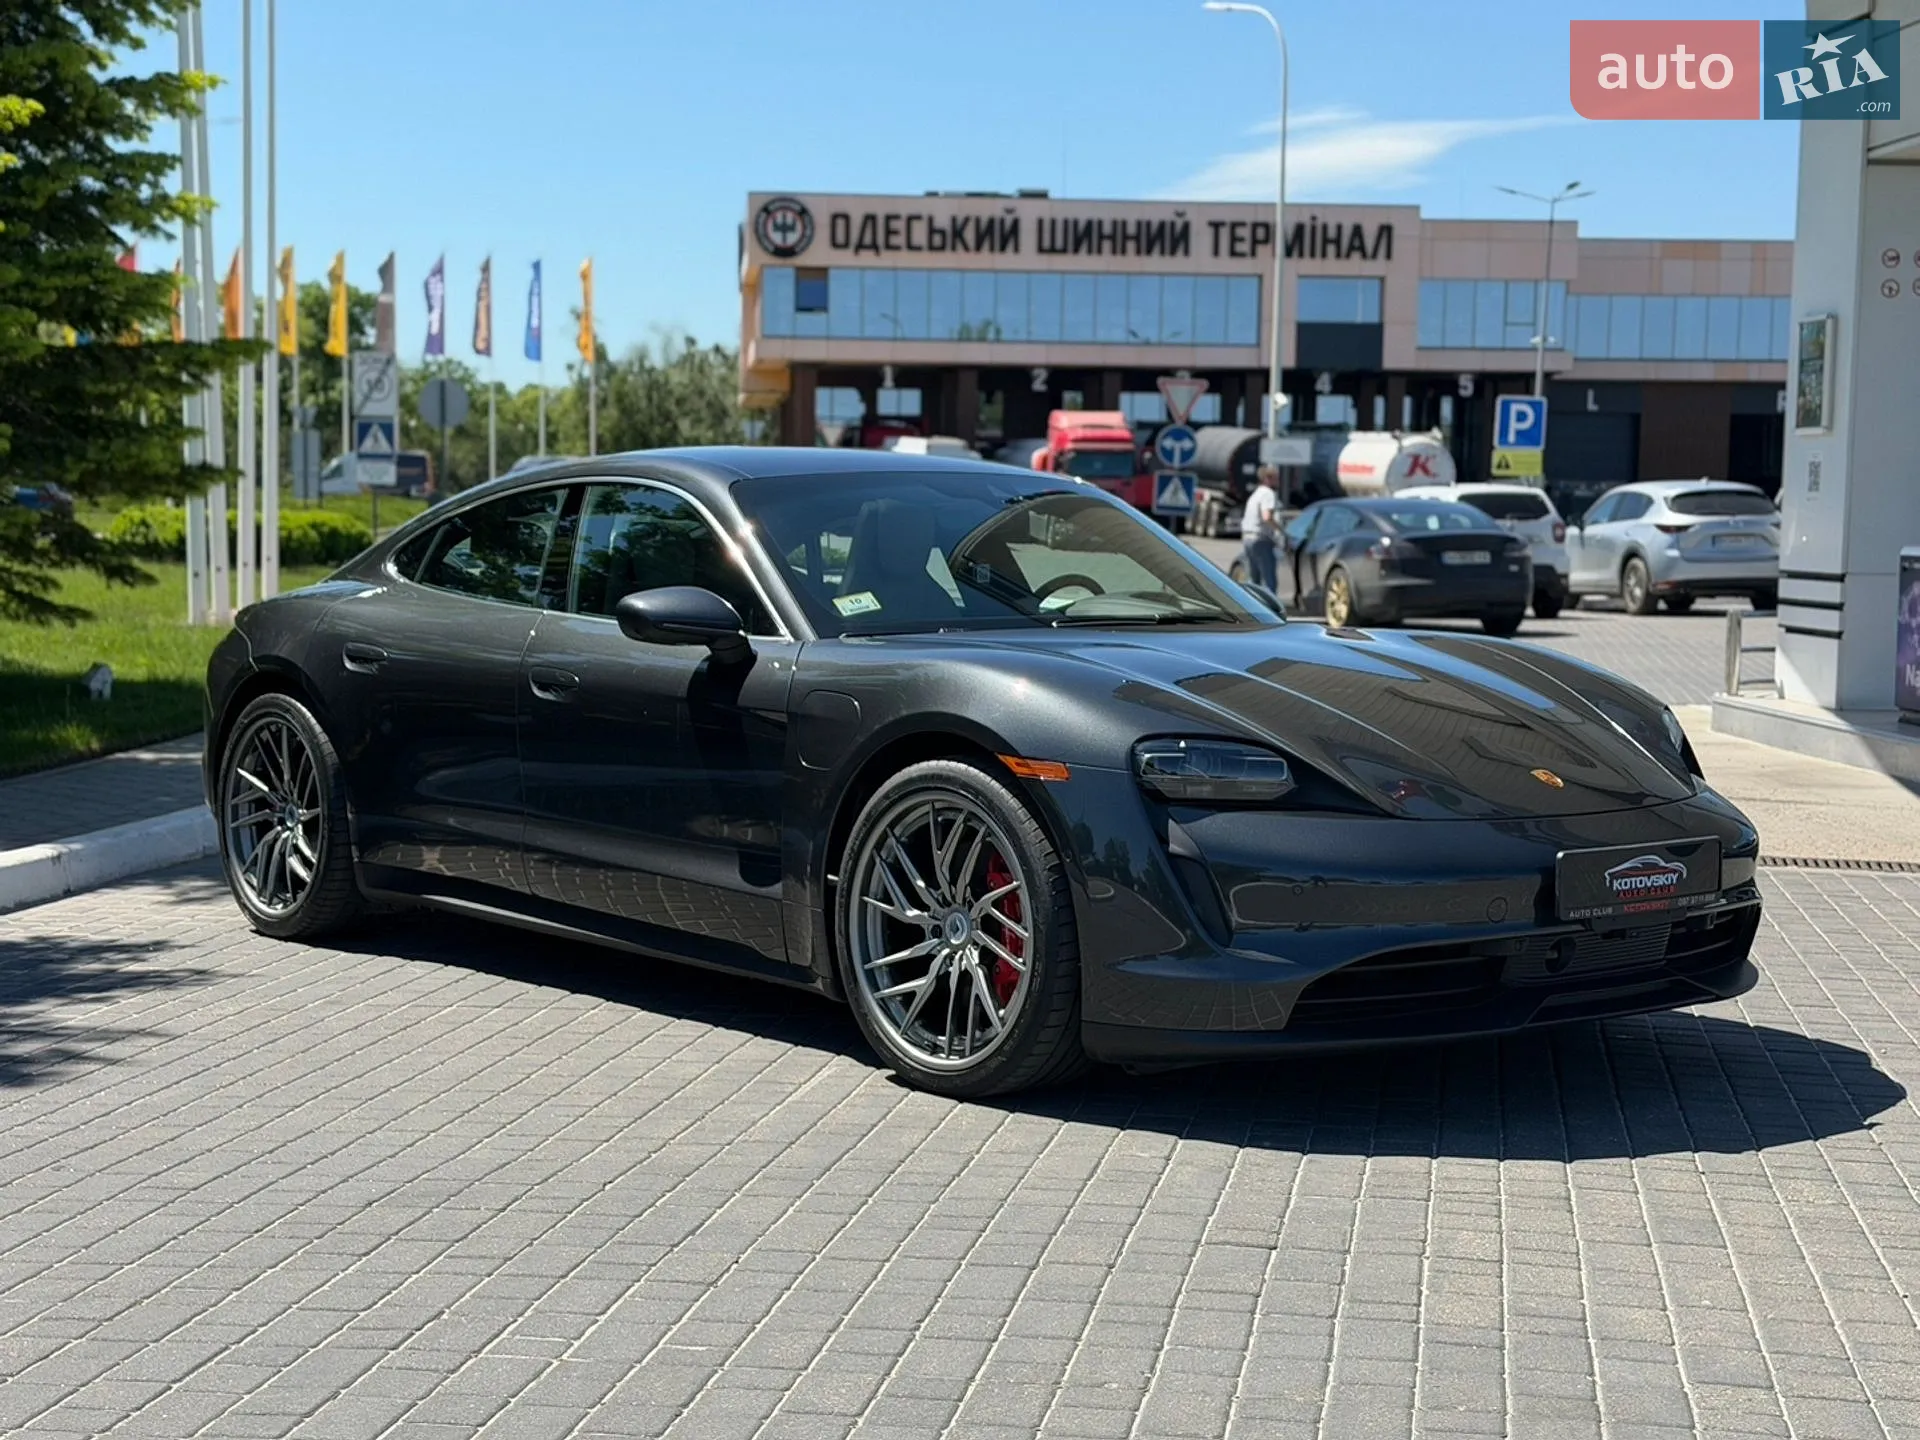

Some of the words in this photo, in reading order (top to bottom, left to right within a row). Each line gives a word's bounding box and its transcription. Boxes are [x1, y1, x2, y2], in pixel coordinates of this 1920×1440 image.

[829, 207, 1021, 257] ОДЕСЬКИЙ
[1036, 210, 1192, 258] ШИННИЙ
[1207, 214, 1393, 262] ТЕРМІНАЛ
[883, 365, 895, 389] 1
[1031, 367, 1048, 392] 2
[1314, 371, 1333, 394] 4
[1457, 374, 1475, 398] 5
[1586, 388, 1599, 411] L
[1507, 402, 1536, 445] P
[1404, 452, 1438, 479] K
[1613, 873, 1679, 890] KOTOVSKIY
[1618, 890, 1646, 898] AUTO
[1569, 908, 1591, 918] AUTO
